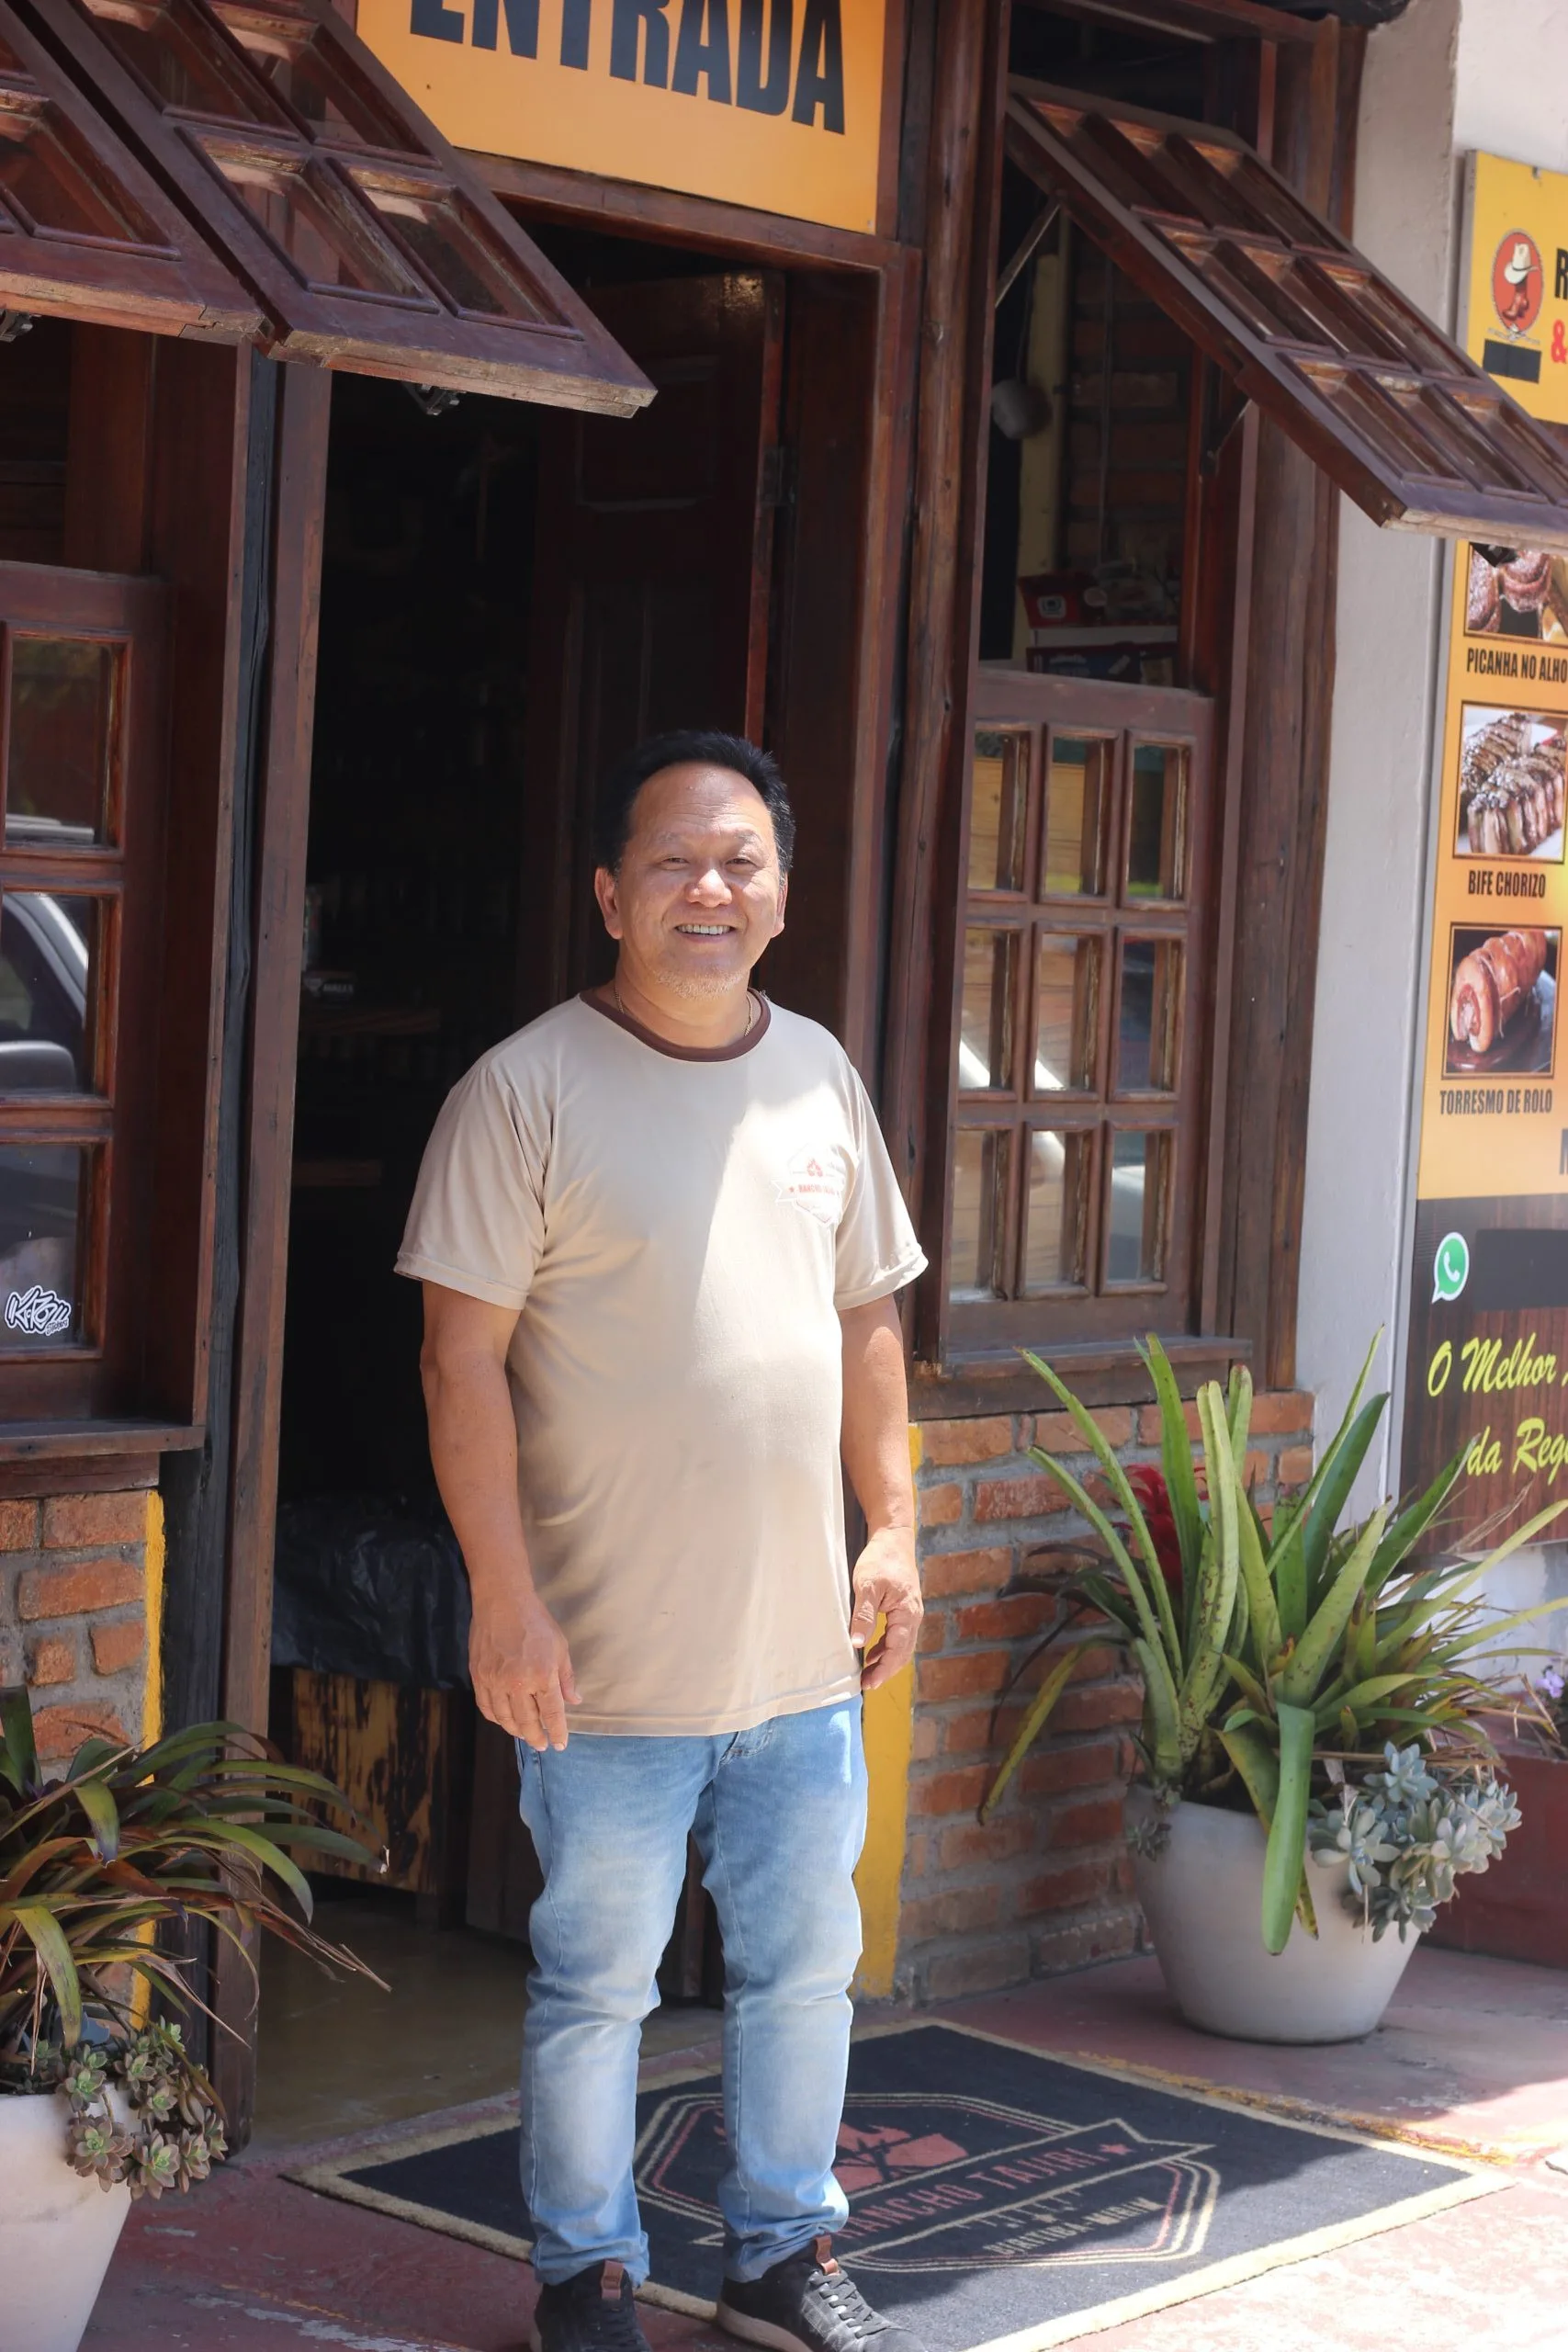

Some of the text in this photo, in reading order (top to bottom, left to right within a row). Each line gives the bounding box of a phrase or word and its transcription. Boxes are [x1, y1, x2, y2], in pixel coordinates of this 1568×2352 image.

[410, 0, 845, 135] RADA
[1466, 647, 1568, 684] PICANHA NO ALHO
[1468, 870, 1546, 899] BIFE CHORIZO
[1440, 1089, 1552, 1115] TORRESMO DE ROLO
[1428, 1332, 1556, 1397] O Melhor
[1467, 1426, 1503, 1476] da
